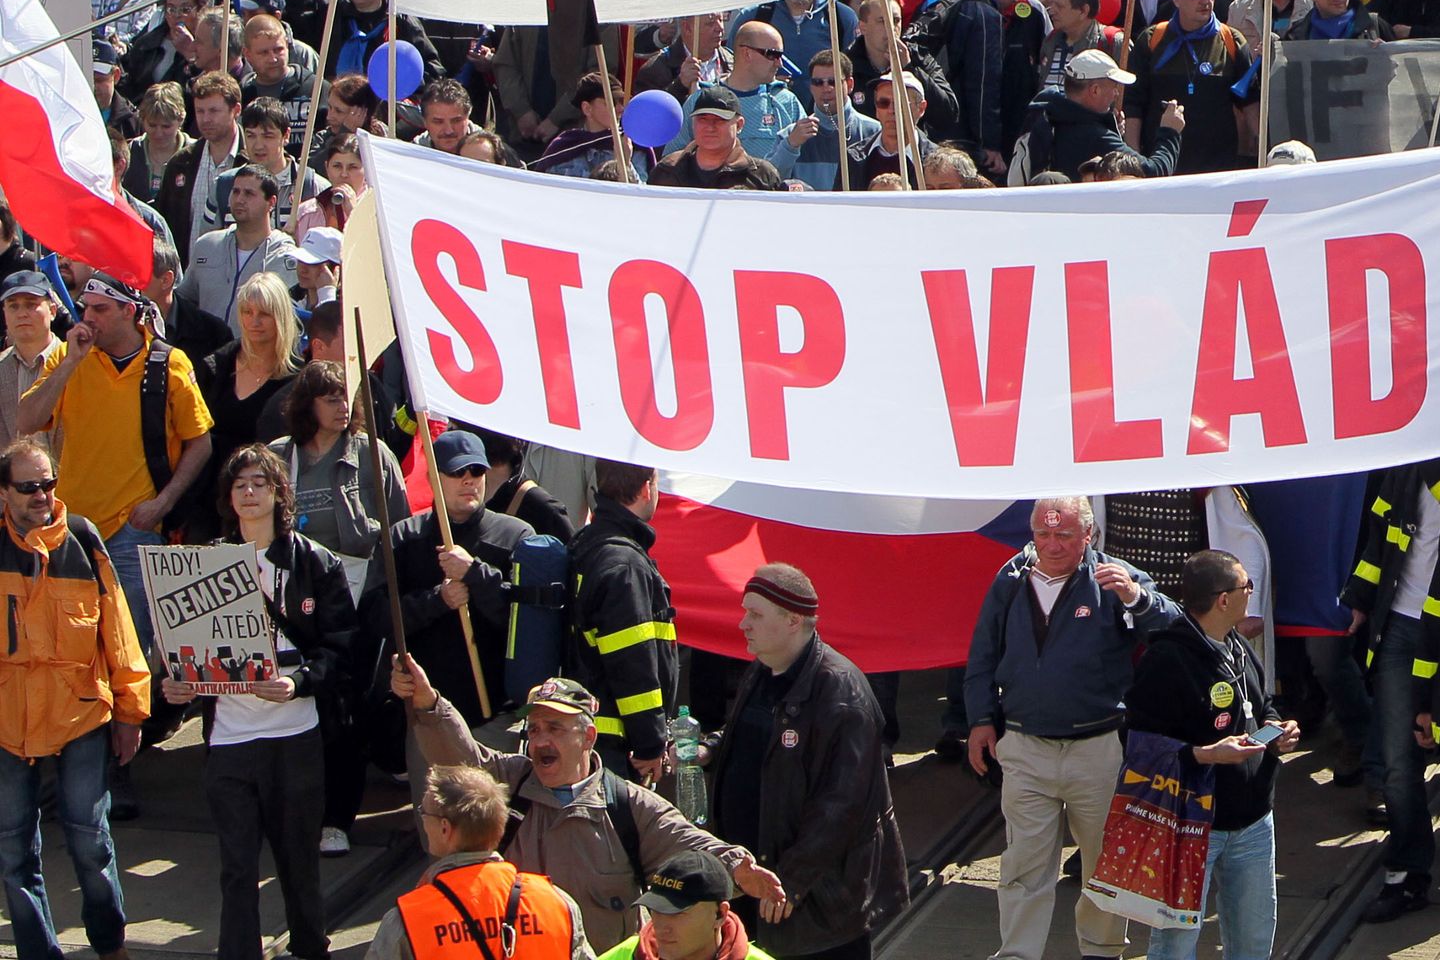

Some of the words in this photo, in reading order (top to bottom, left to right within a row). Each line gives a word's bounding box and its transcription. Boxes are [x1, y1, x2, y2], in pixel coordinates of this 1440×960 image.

[1286, 56, 1380, 146] IF
[408, 216, 848, 462] STOP
[148, 552, 203, 577] TADY!
[157, 560, 258, 630] DEMISI!
[1147, 812, 1167, 826] VAŠE
